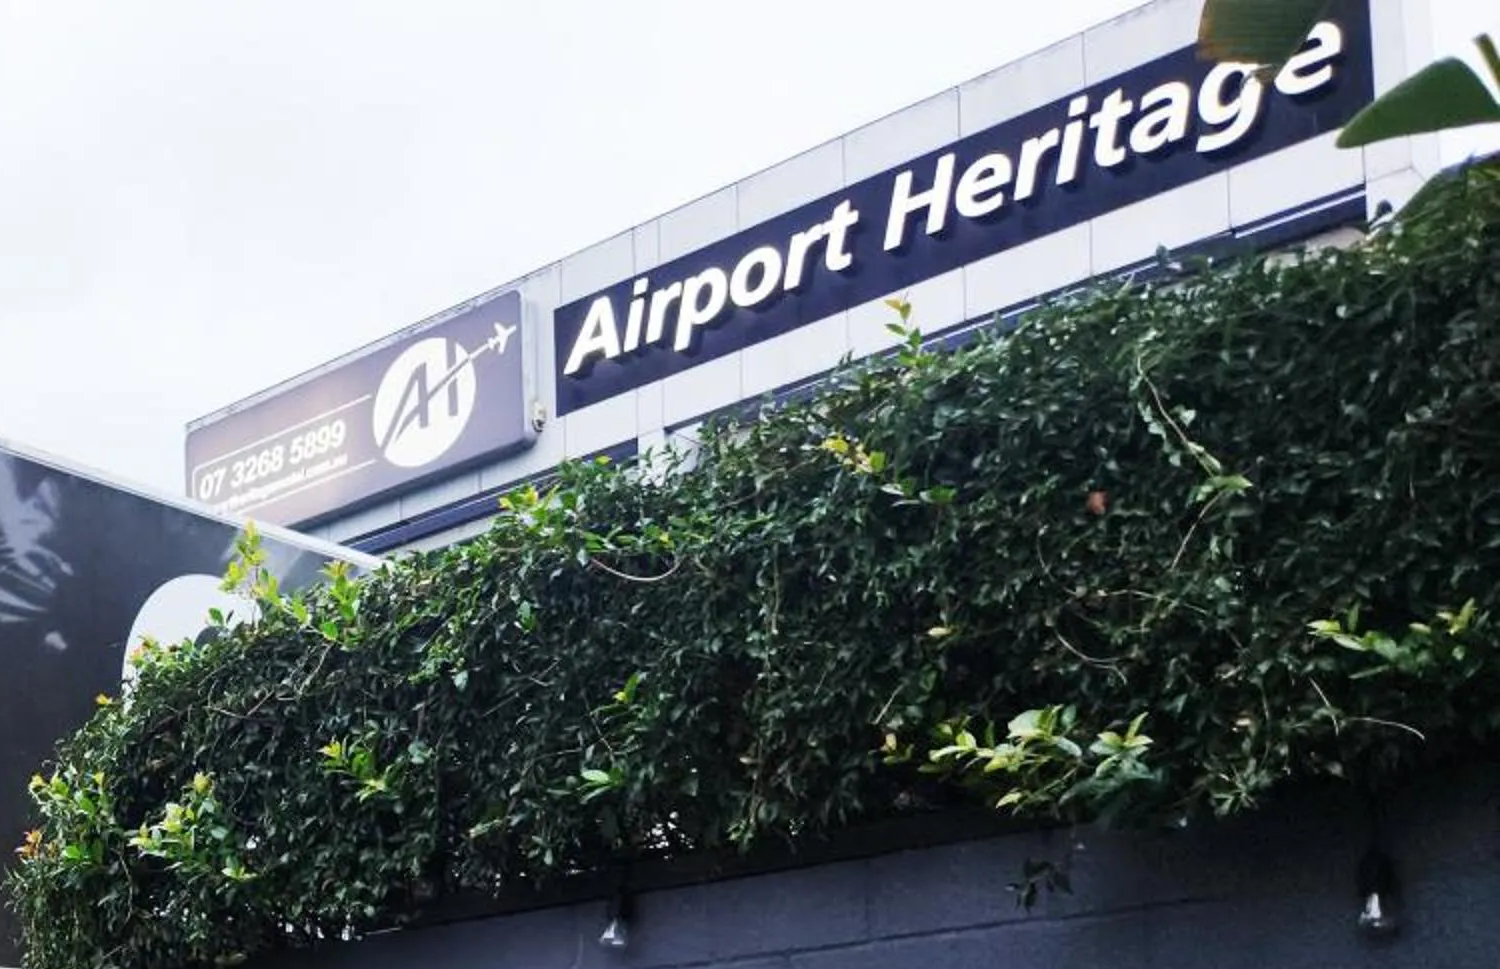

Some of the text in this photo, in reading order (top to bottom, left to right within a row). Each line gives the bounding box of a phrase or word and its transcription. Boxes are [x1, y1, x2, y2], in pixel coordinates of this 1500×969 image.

[564, 21, 1342, 377] Airport Heritage
[200, 467, 227, 499] 07
[230, 445, 284, 488] 3268
[288, 419, 346, 464] 5899
